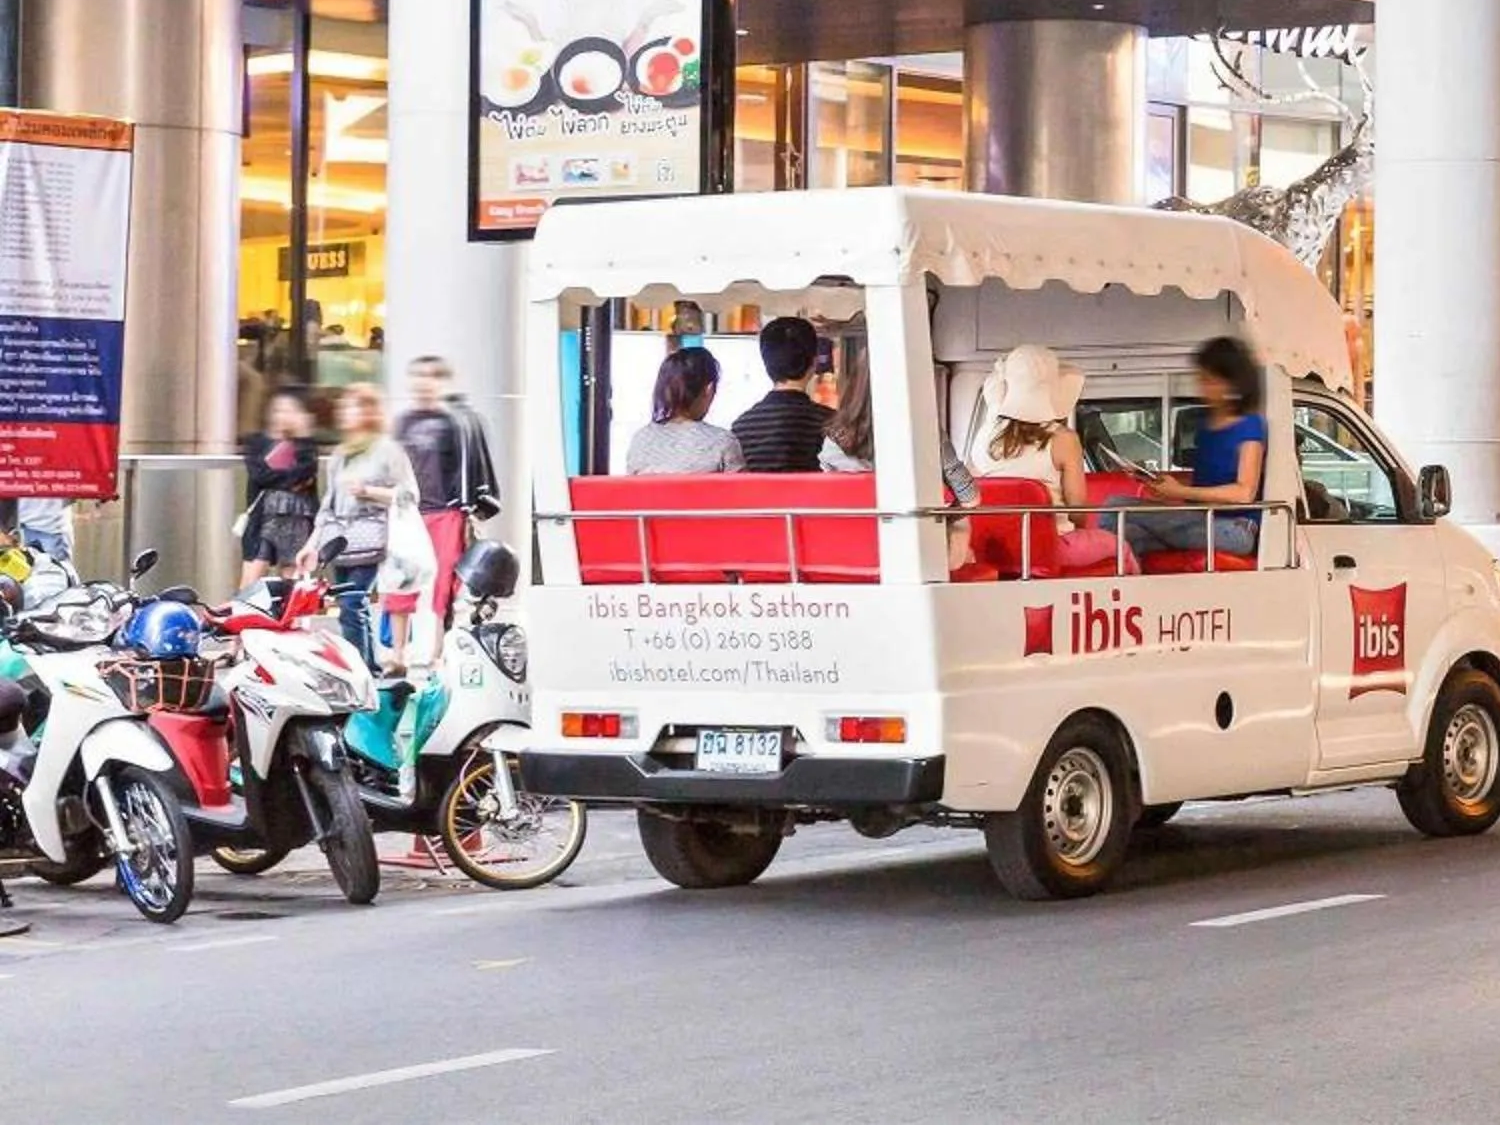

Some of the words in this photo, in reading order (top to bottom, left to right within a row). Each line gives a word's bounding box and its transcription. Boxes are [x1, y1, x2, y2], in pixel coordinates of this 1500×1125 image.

[588, 593, 629, 619] ibis
[637, 594, 742, 625] Bangkok
[750, 592, 850, 619] Sathorn
[1070, 589, 1144, 655] ibis
[624, 628, 635, 649] T
[644, 631, 676, 651] +66
[682, 630, 711, 653] (0)
[718, 631, 762, 651] 2610
[769, 631, 814, 652] 5188
[1358, 614, 1401, 659] ibis
[609, 660, 841, 686] ibishotel.com/Thailand
[735, 732, 778, 756] 8132
